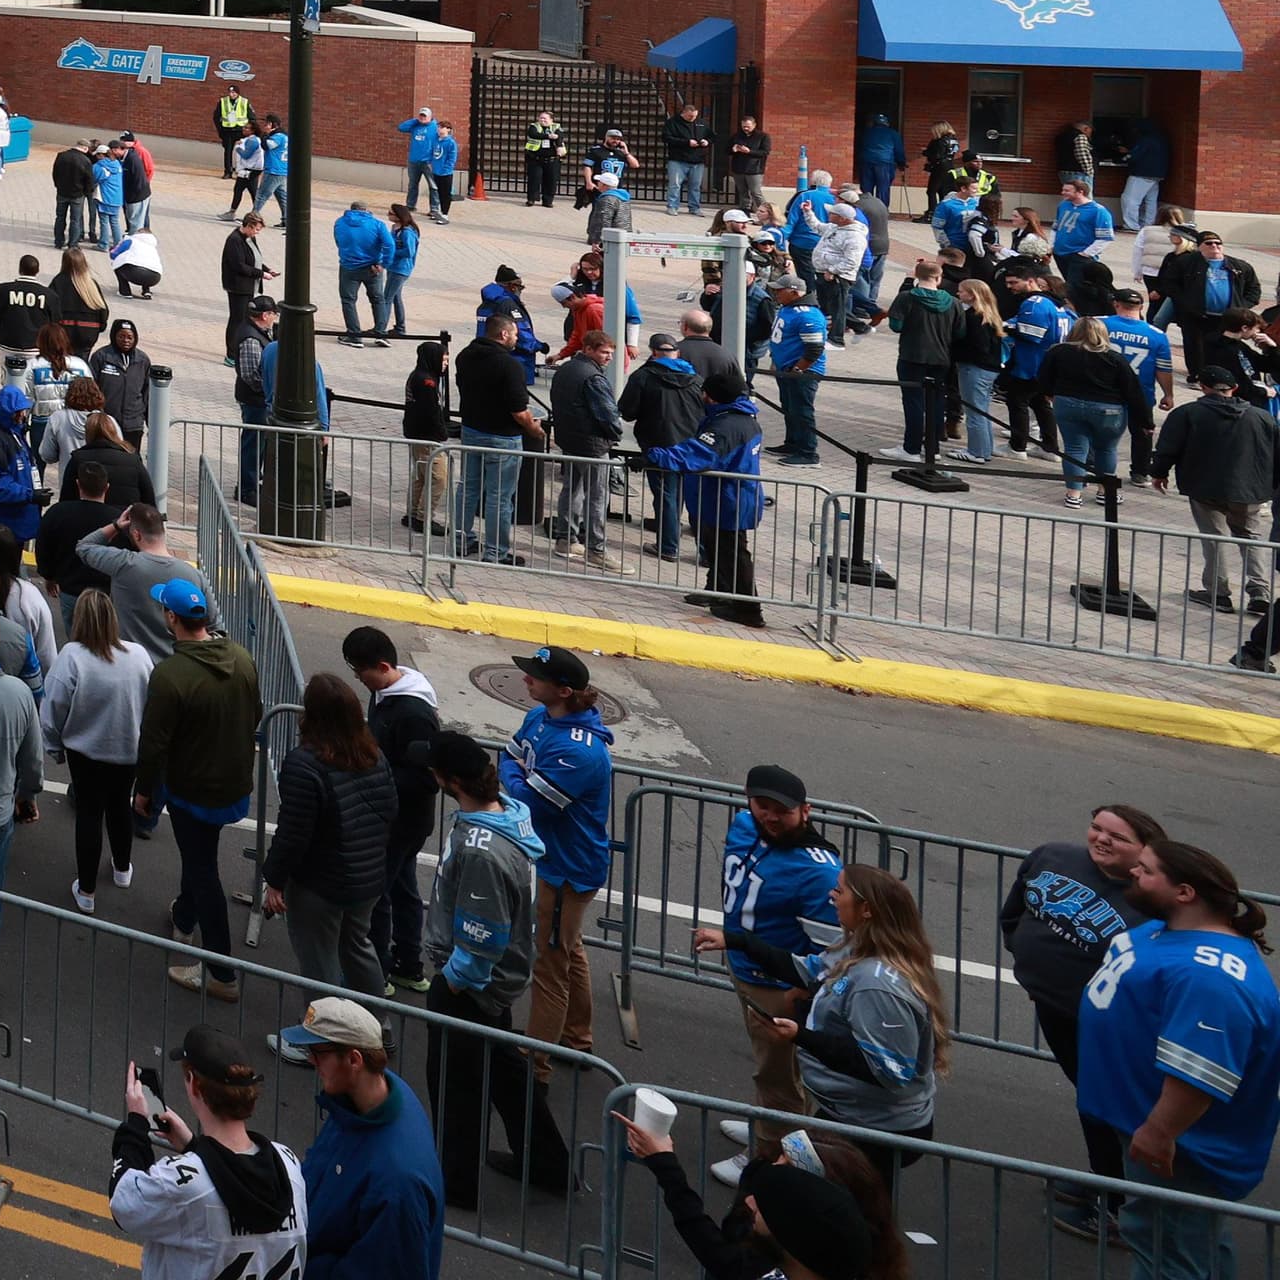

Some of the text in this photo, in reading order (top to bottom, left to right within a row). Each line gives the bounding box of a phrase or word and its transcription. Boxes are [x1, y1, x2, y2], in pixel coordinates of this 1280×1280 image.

[112, 45, 163, 85] GATE A
[165, 66, 197, 75] ENTRANCE
[167, 58, 203, 68] EXECUTIVE
[601, 160, 624, 175] 97
[1059, 209, 1080, 235] 14
[1109, 331, 1149, 346] APORTA
[1113, 346, 1149, 375] 7
[569, 726, 593, 747] 81
[465, 827, 493, 851] 32
[804, 846, 837, 867] 81
[724, 853, 764, 932] 81
[1026, 871, 1127, 939] DETROIT
[1193, 944, 1248, 982] 58
